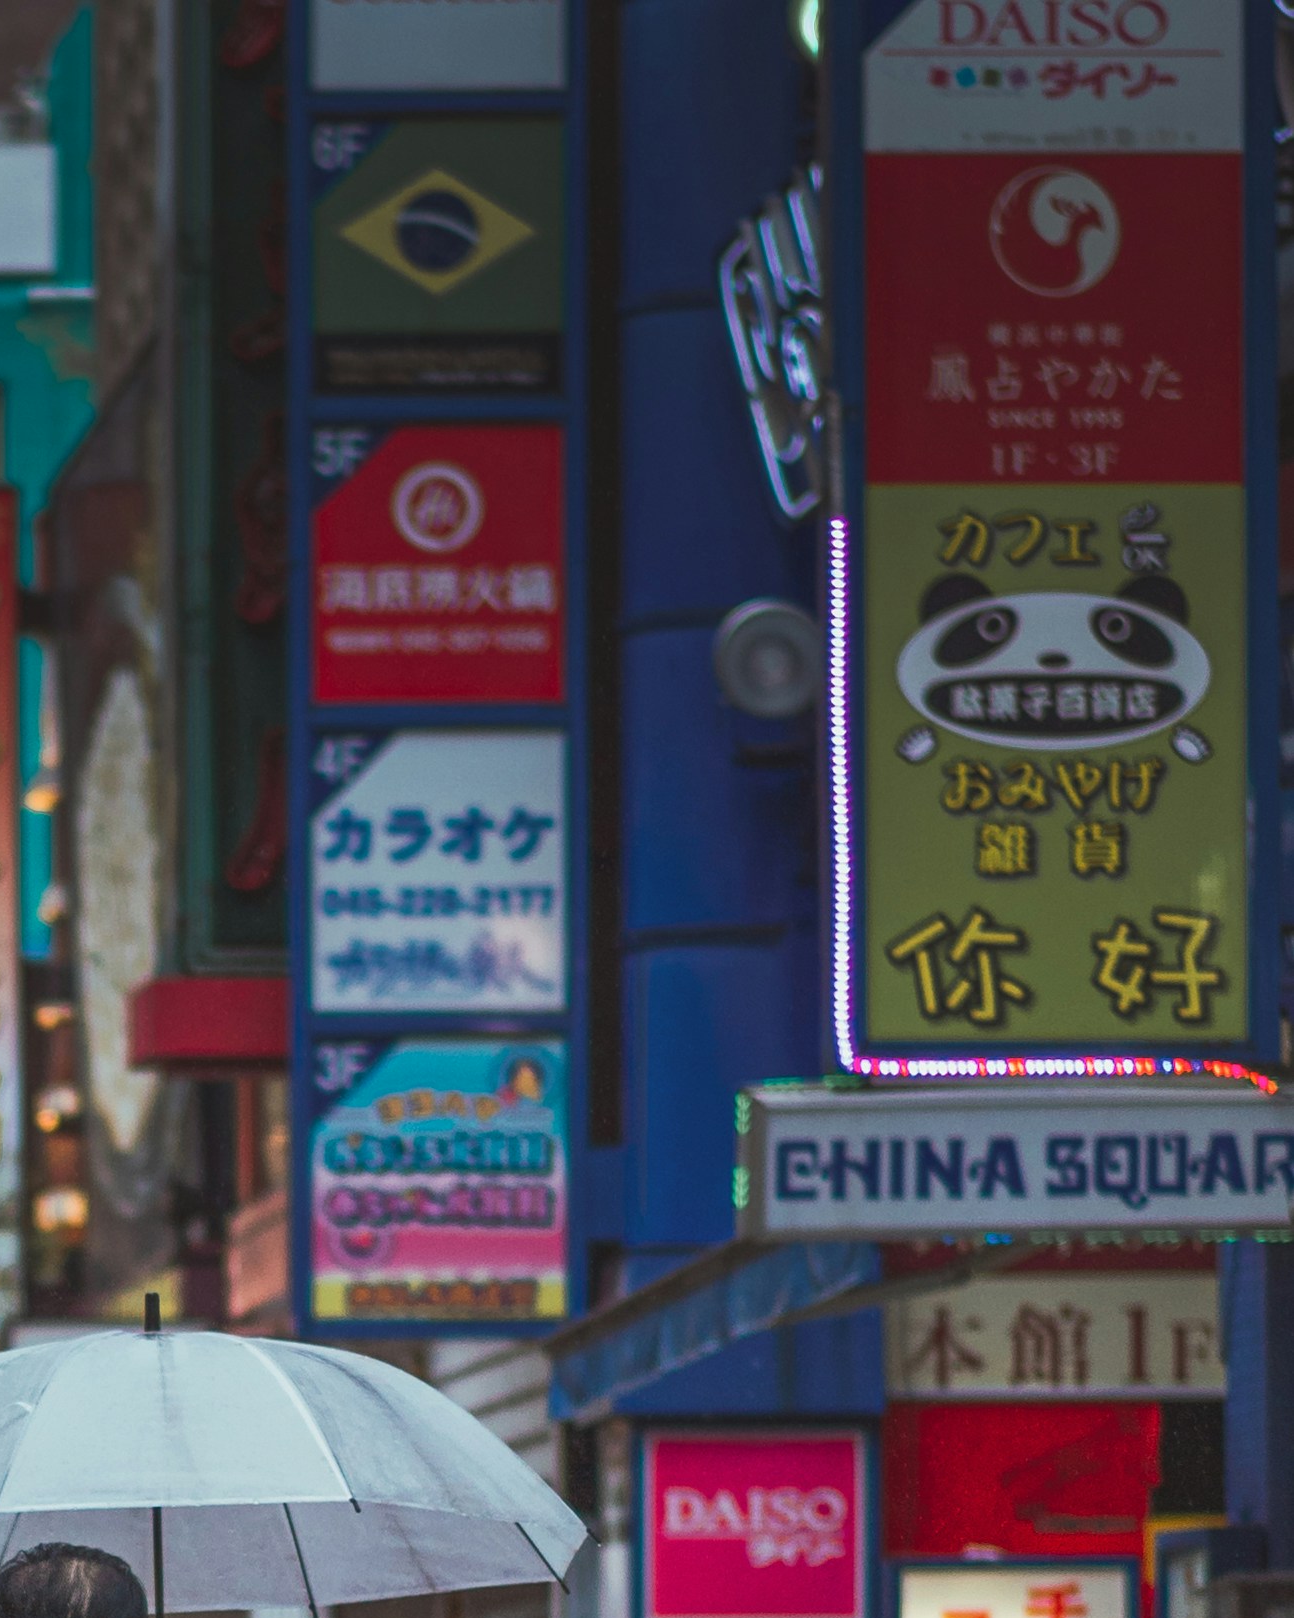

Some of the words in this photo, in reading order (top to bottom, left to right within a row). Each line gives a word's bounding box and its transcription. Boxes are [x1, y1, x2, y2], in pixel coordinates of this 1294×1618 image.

[937, 0, 1169, 47] DAISO
[1039, 61, 1178, 99] ダイソー
[313, 123, 372, 172] 6F
[313, 431, 368, 477] 5F
[314, 738, 368, 782] 4F
[942, 758, 1164, 812] おみやげ
[323, 806, 554, 862] カラオケ
[890, 912, 1219, 1020] 你好
[314, 1045, 366, 1091] 3F
[774, 1135, 1027, 1200] CHINA
[662, 1486, 848, 1537] DAISO
